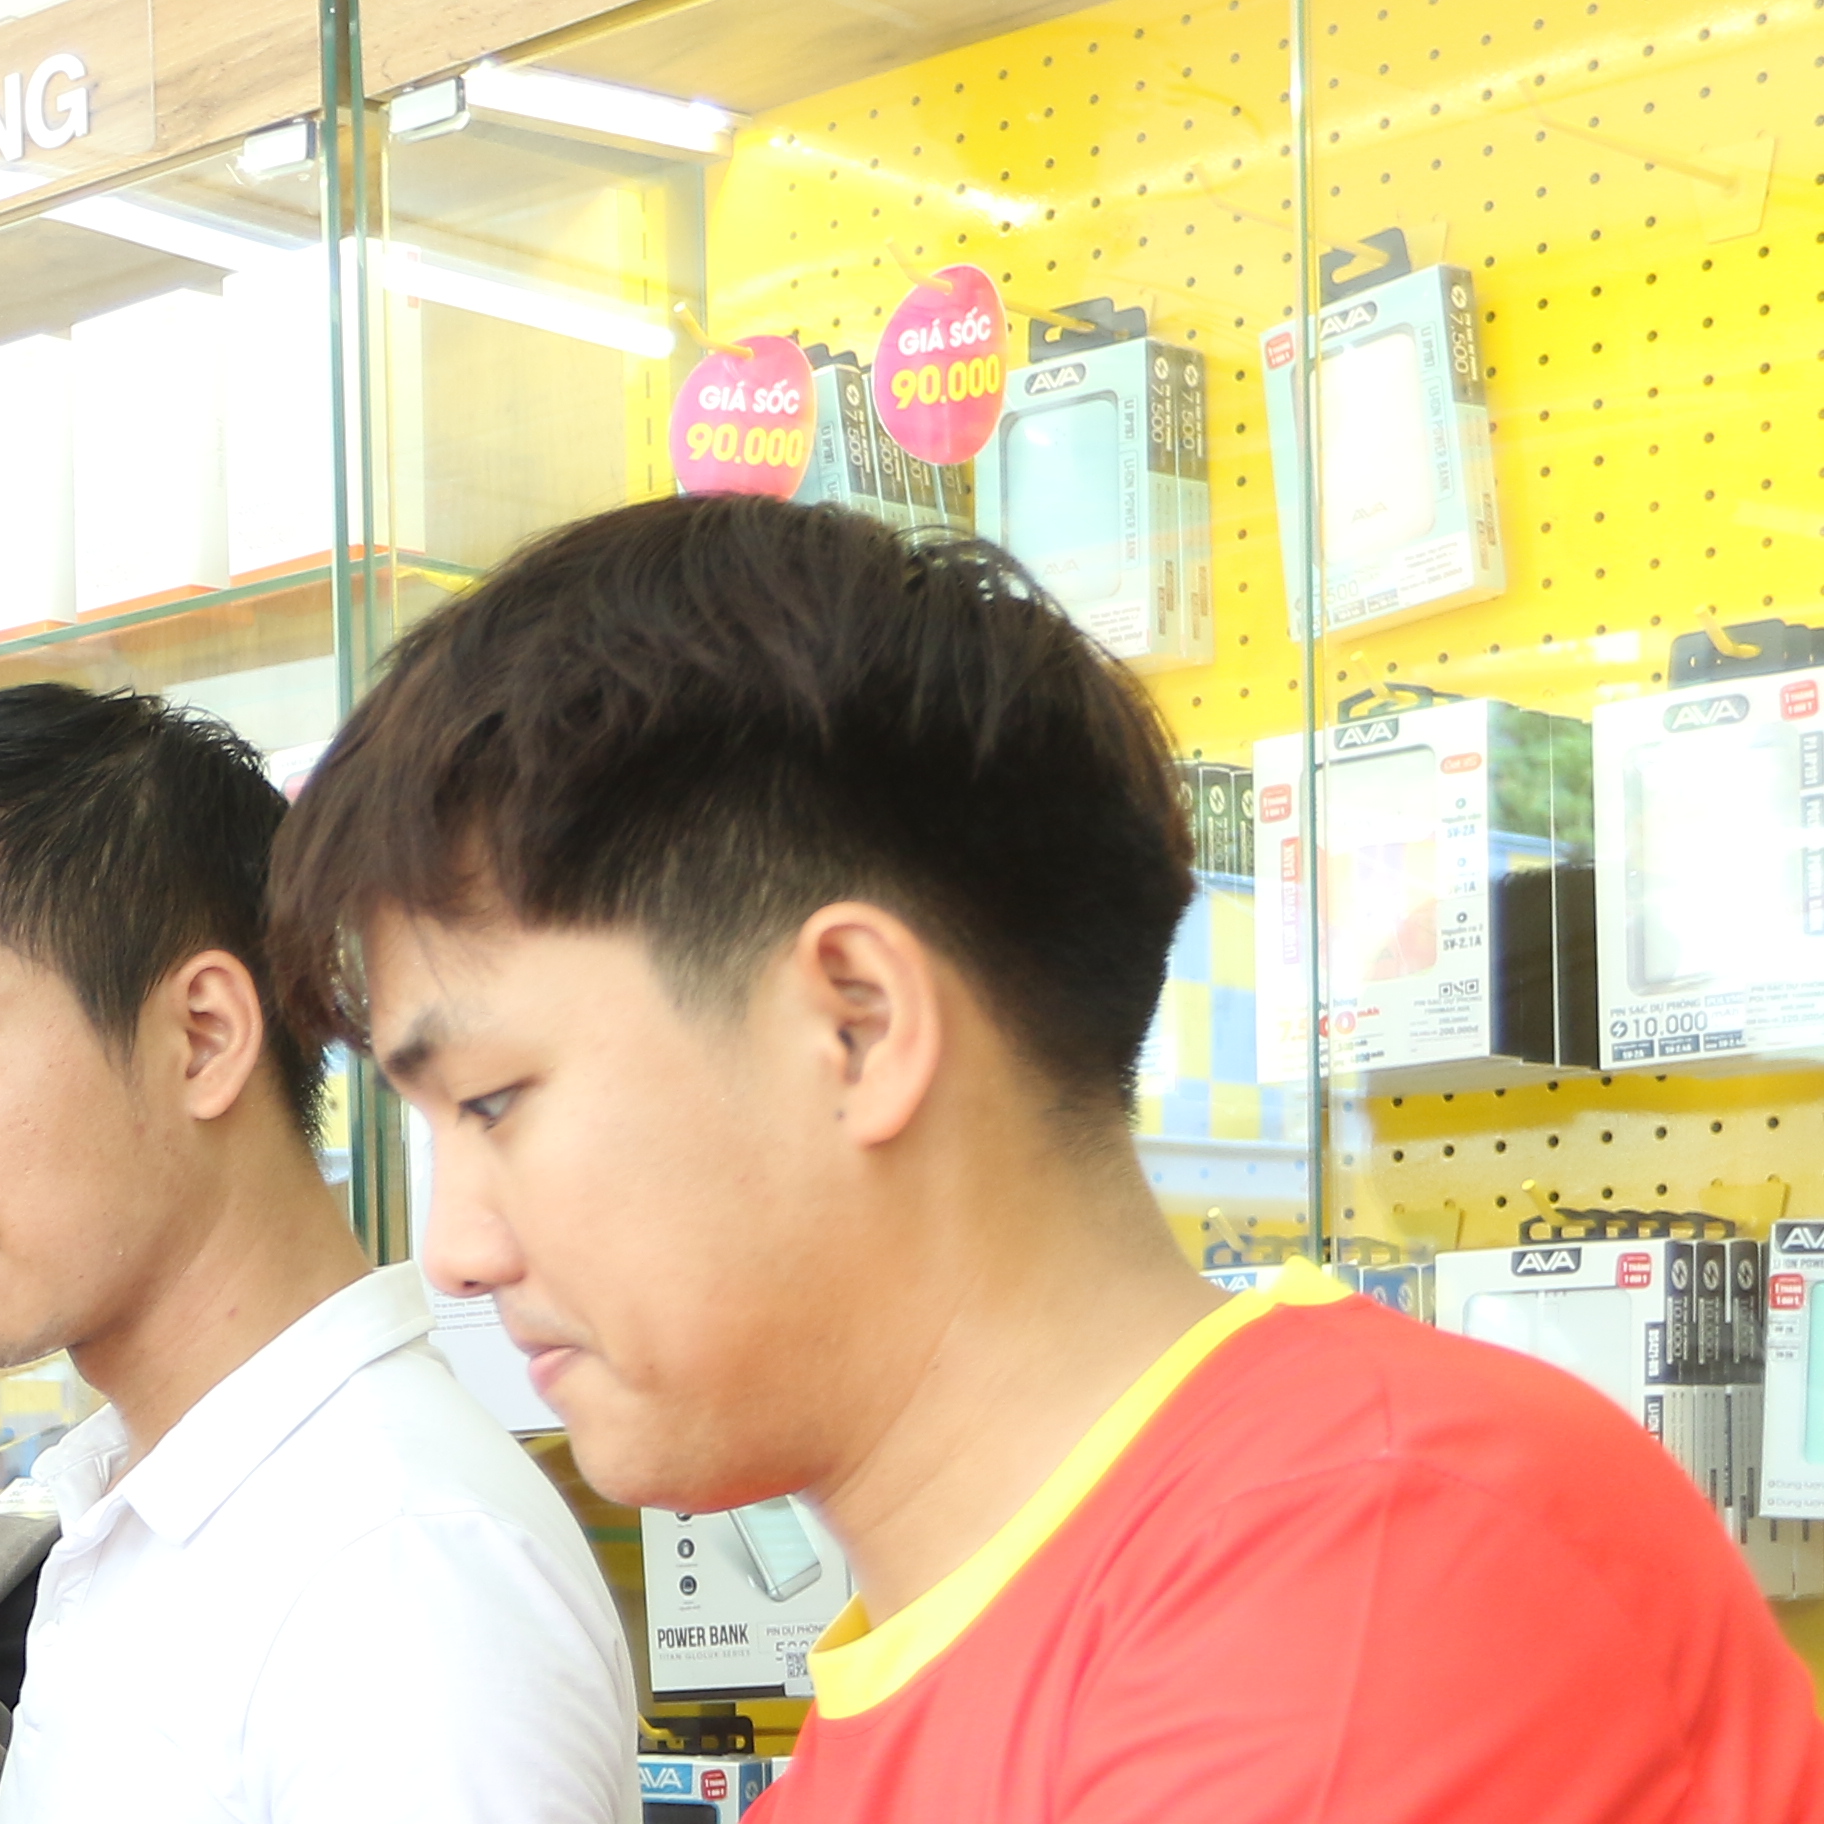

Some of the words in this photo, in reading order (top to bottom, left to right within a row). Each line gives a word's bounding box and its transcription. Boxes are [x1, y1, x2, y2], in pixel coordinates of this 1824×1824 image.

[898, 319, 944, 355] GIÁ
[949, 307, 991, 345] SỐC
[1320, 307, 1372, 338] AVA
[1449, 313, 1468, 374] 7.500
[891, 354, 999, 409] 90.000
[1030, 366, 1082, 394] AVA
[699, 377, 746, 412] GIÁ
[753, 379, 800, 415] SỐC
[686, 423, 804, 467] 90.000
[1672, 699, 1740, 729] AVA
[1339, 722, 1392, 748] AVA
[1634, 1011, 1708, 1038] 10.000
[1782, 1227, 1824, 1249] AV
[1517, 1251, 1576, 1273] AVA
[658, 1626, 706, 1649] POWER
[710, 1623, 749, 1647] BANK
[767, 1626, 781, 1636] PIN
